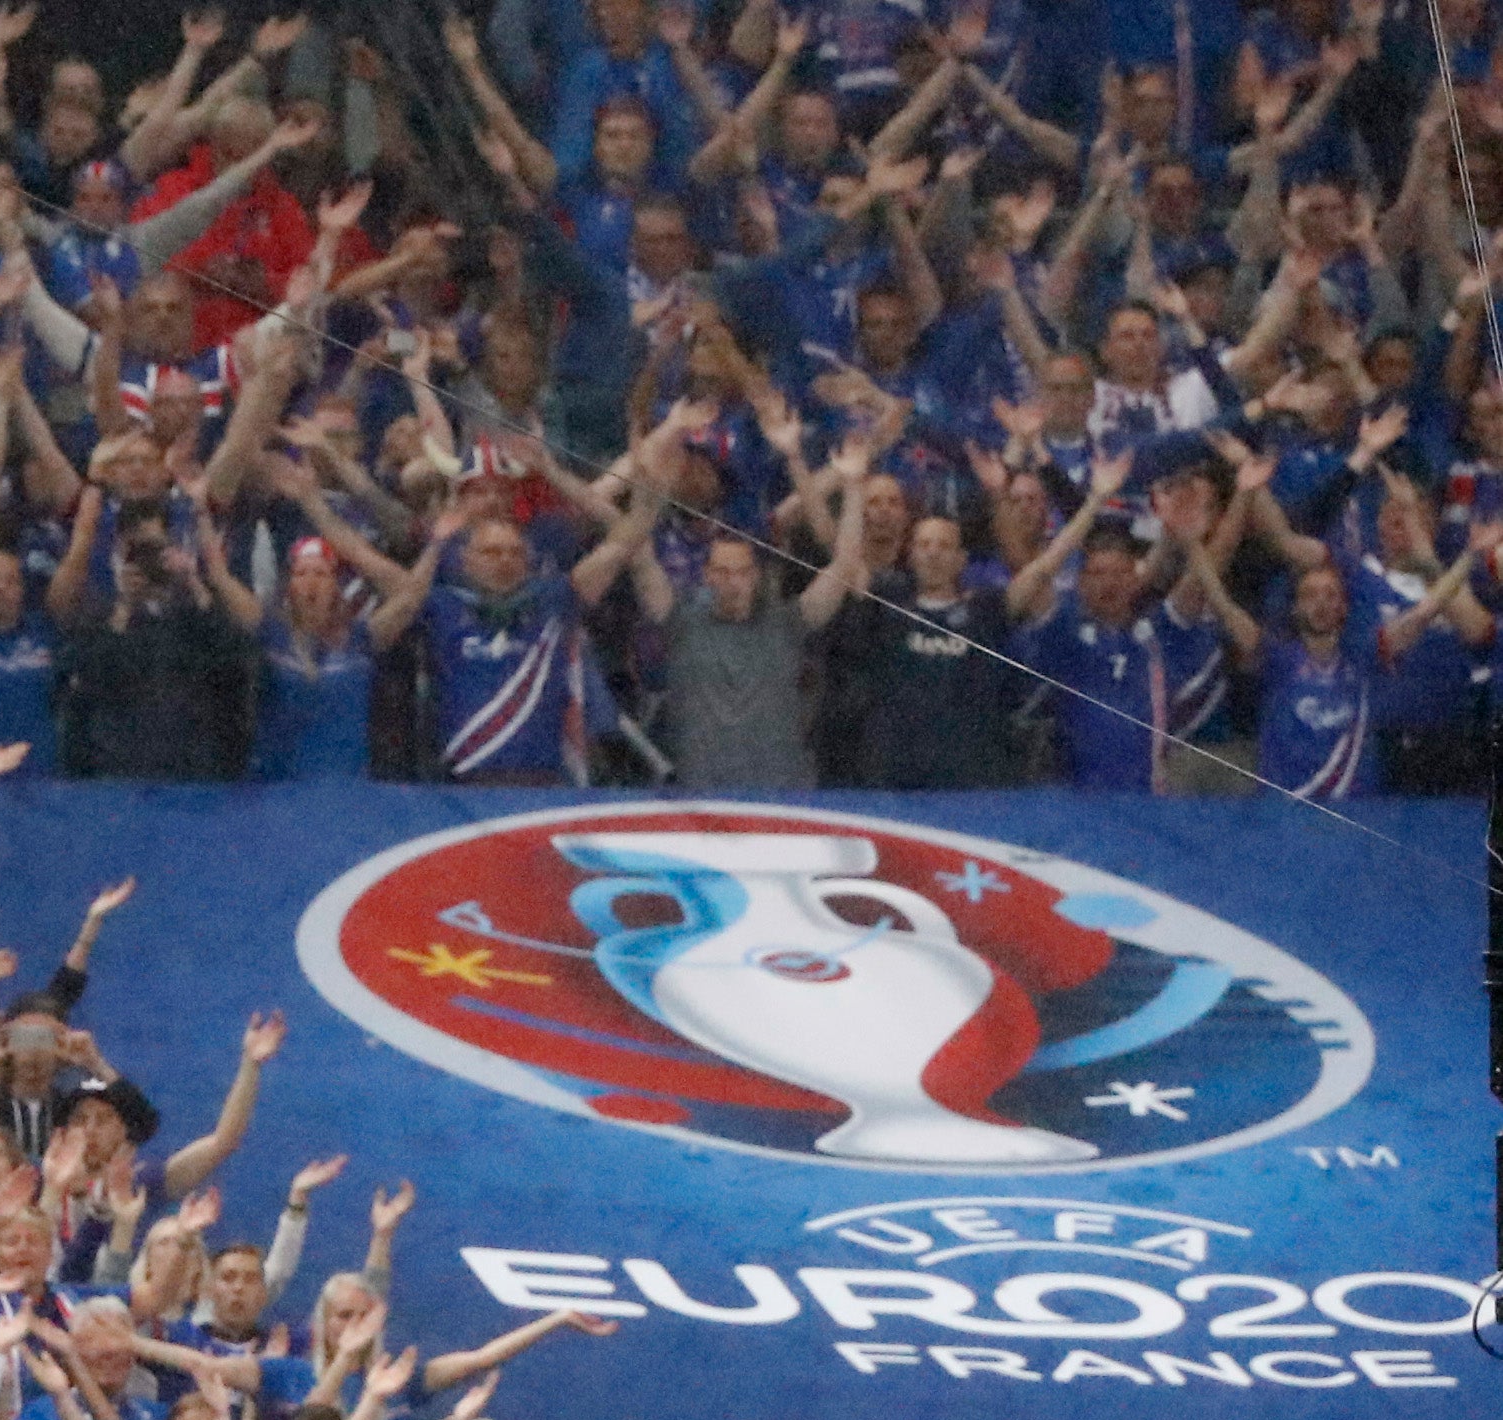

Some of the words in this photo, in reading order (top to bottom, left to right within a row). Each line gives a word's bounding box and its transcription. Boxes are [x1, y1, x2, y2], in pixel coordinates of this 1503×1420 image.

[835, 1207, 1210, 1263] UEFA
[458, 1245, 1503, 1340] EURO20
[833, 1340, 1458, 1388] FRANCE
